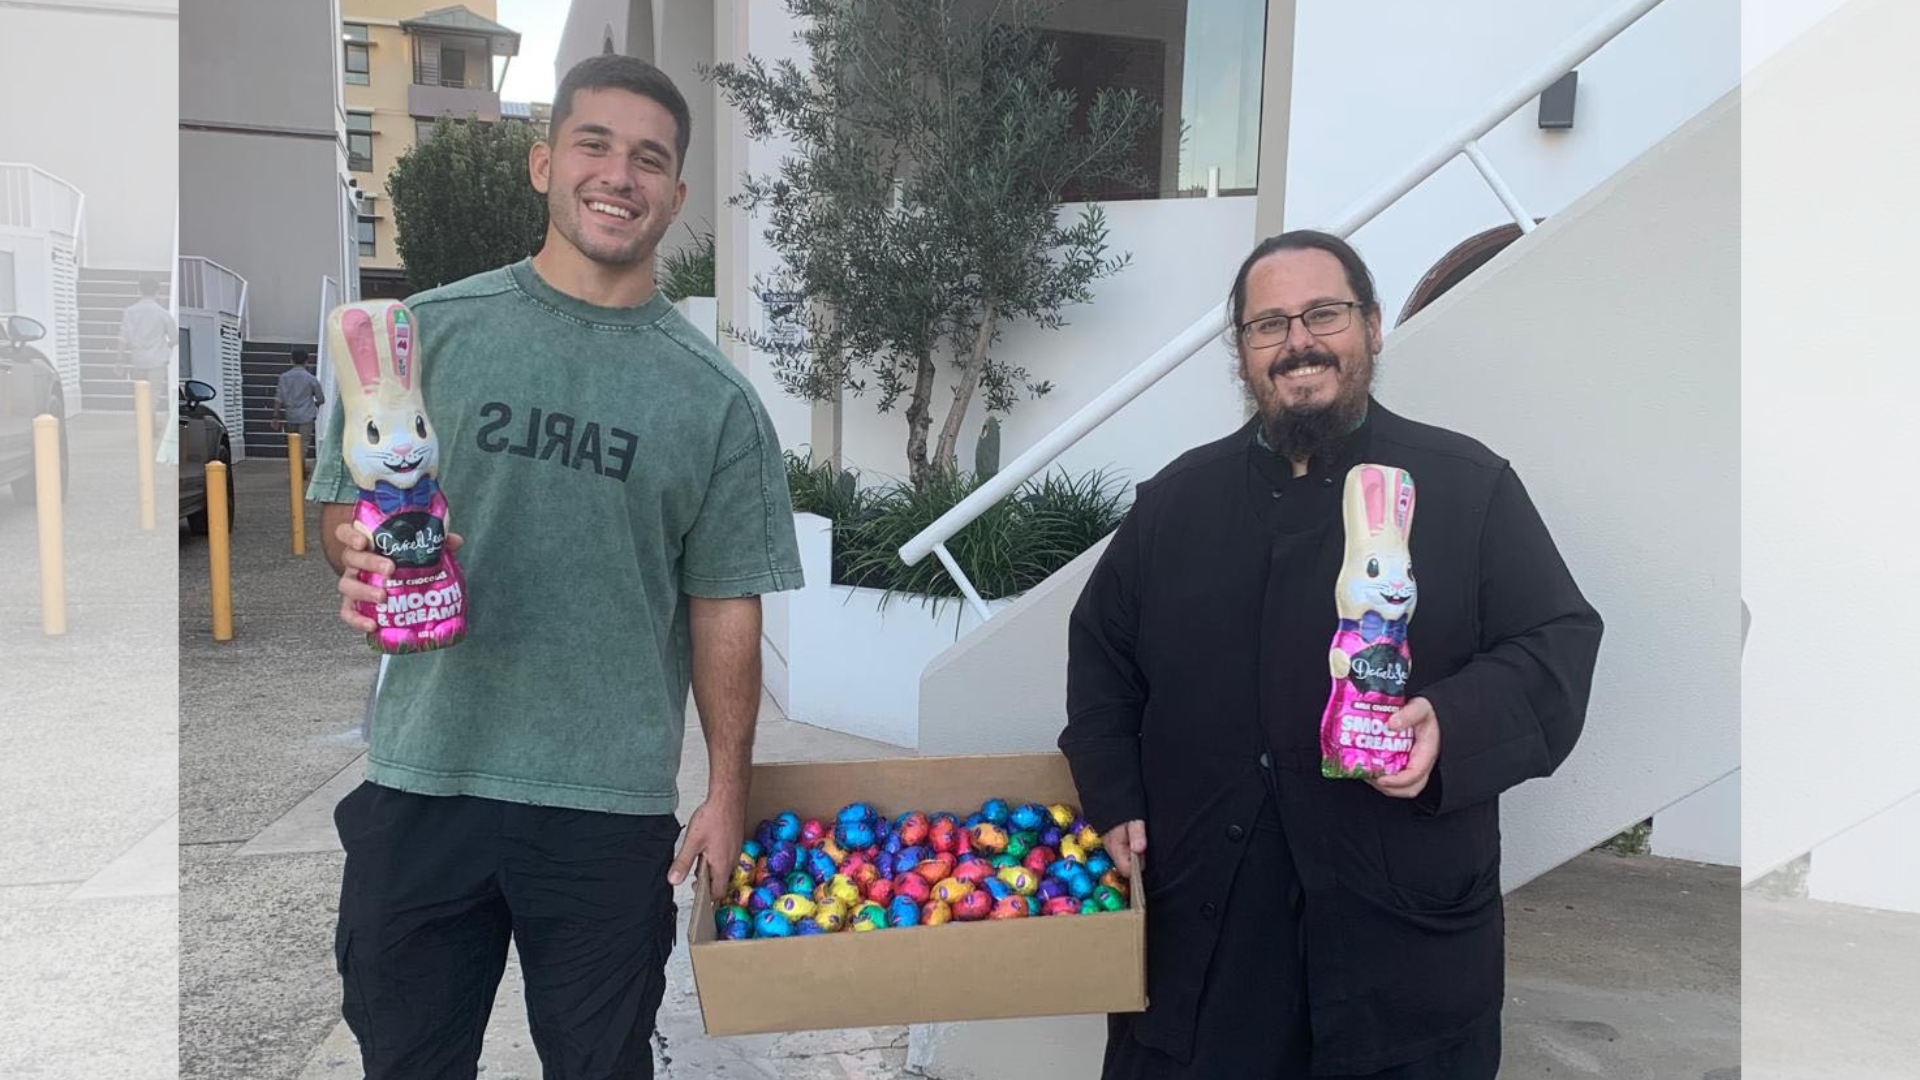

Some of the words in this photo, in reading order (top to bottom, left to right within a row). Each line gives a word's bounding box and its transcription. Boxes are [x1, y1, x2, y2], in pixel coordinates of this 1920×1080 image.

[377, 613, 391, 627] &
[394, 599, 462, 627] CREAMY
[1340, 731, 1352, 746] &
